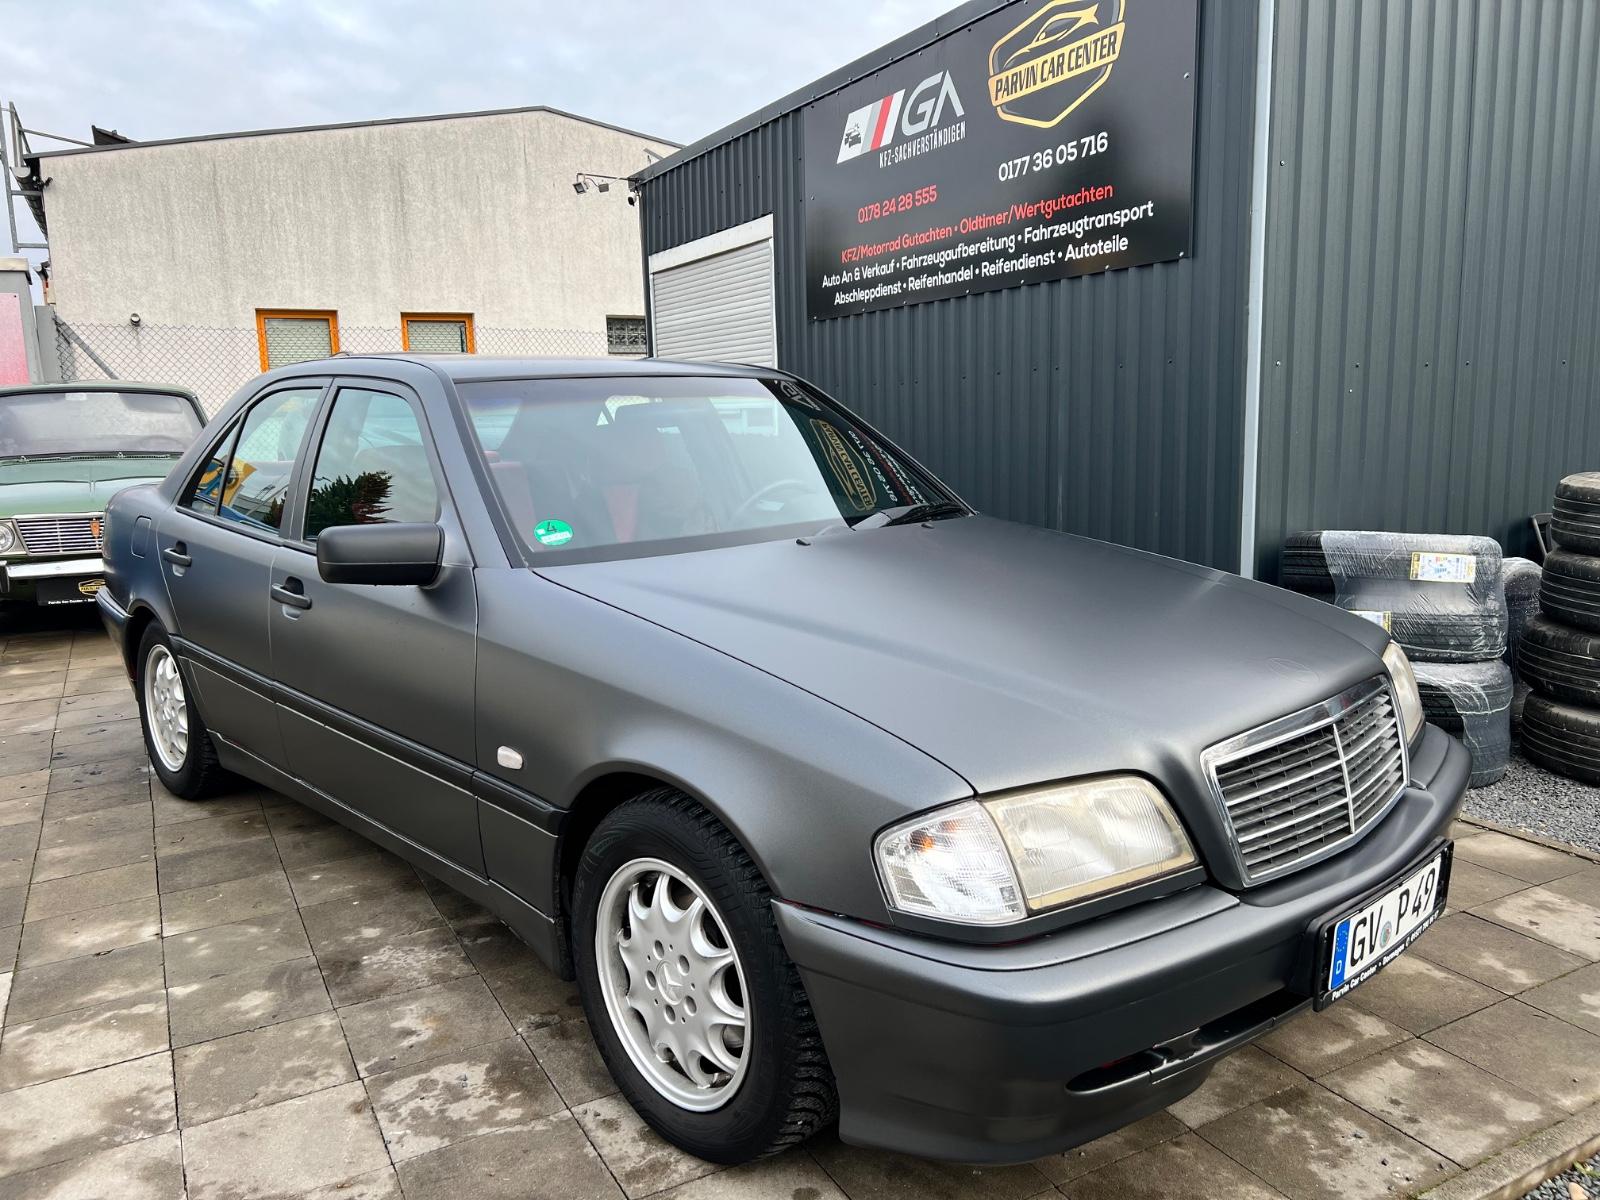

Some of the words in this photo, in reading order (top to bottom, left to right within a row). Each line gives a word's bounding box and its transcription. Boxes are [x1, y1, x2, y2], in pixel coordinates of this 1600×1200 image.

[994, 64, 1038, 101] PARVIN
[1041, 53, 1065, 83] CAR
[1067, 31, 1118, 72] CENTER
[901, 69, 965, 136] GA
[879, 121, 966, 168] KFZ-SACHVERSTÄNDIGEN
[998, 156, 1030, 181] 0177
[1032, 149, 1053, 171] 36
[1056, 141, 1078, 164] 05
[1081, 131, 1109, 158] 716
[841, 237, 901, 263] KFZ/Motorrad
[902, 226, 953, 249] Gutachten
[960, 184, 1114, 234] Oldtimer/Wertgutachten
[857, 203, 880, 223] 0178
[882, 198, 897, 216] 24
[898, 193, 913, 212] 28
[915, 185, 937, 206] 555
[822, 275, 841, 288] Auto
[841, 271, 853, 283] An
[854, 268, 861, 280] &
[861, 259, 895, 279] Verkauf
[901, 233, 1016, 271] Fahrzeugaufbereitung
[1024, 200, 1154, 244] Fahrzeugtransport
[834, 280, 902, 305] Abschleppdienst
[908, 265, 974, 291] Reifenhandel
[981, 250, 1056, 277] Reifendienst
[1064, 234, 1129, 261] Autoteile
[546, 521, 557, 533] 4
[1335, 959, 1343, 975] D
[1350, 905, 1383, 967] GV
